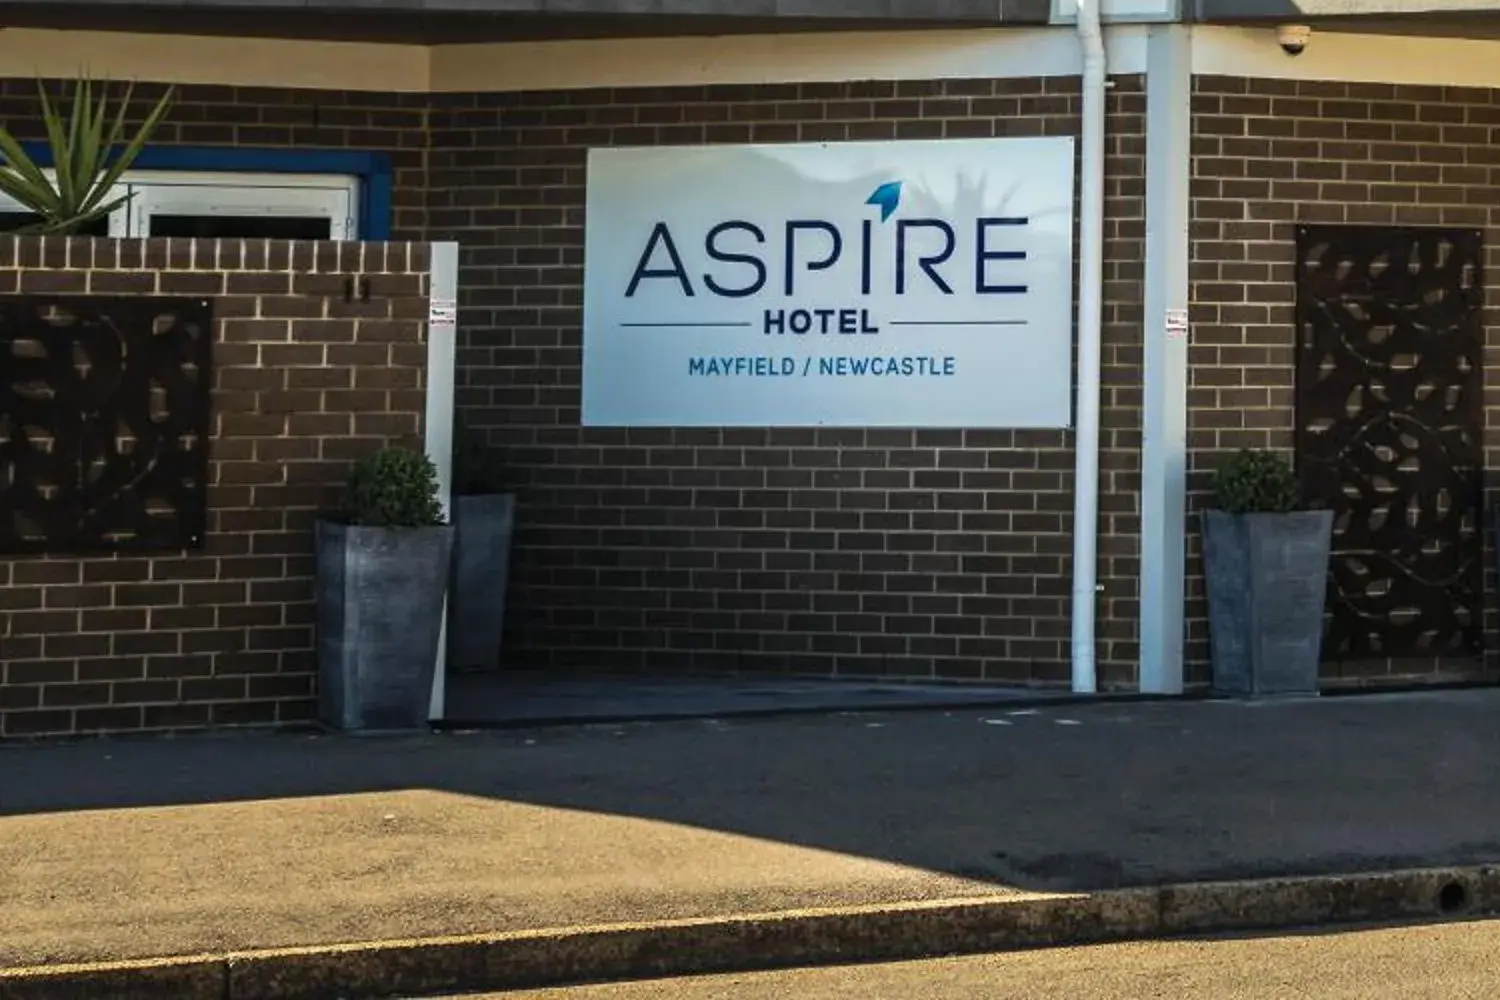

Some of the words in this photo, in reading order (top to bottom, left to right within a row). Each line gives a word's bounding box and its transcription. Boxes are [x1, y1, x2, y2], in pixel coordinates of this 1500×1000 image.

[624, 217, 1029, 297] ASPIRE
[763, 309, 878, 335] HOTEL
[688, 356, 795, 377] MAYFIELD
[802, 357, 811, 377] /
[819, 356, 956, 376] NEWCASTLE
